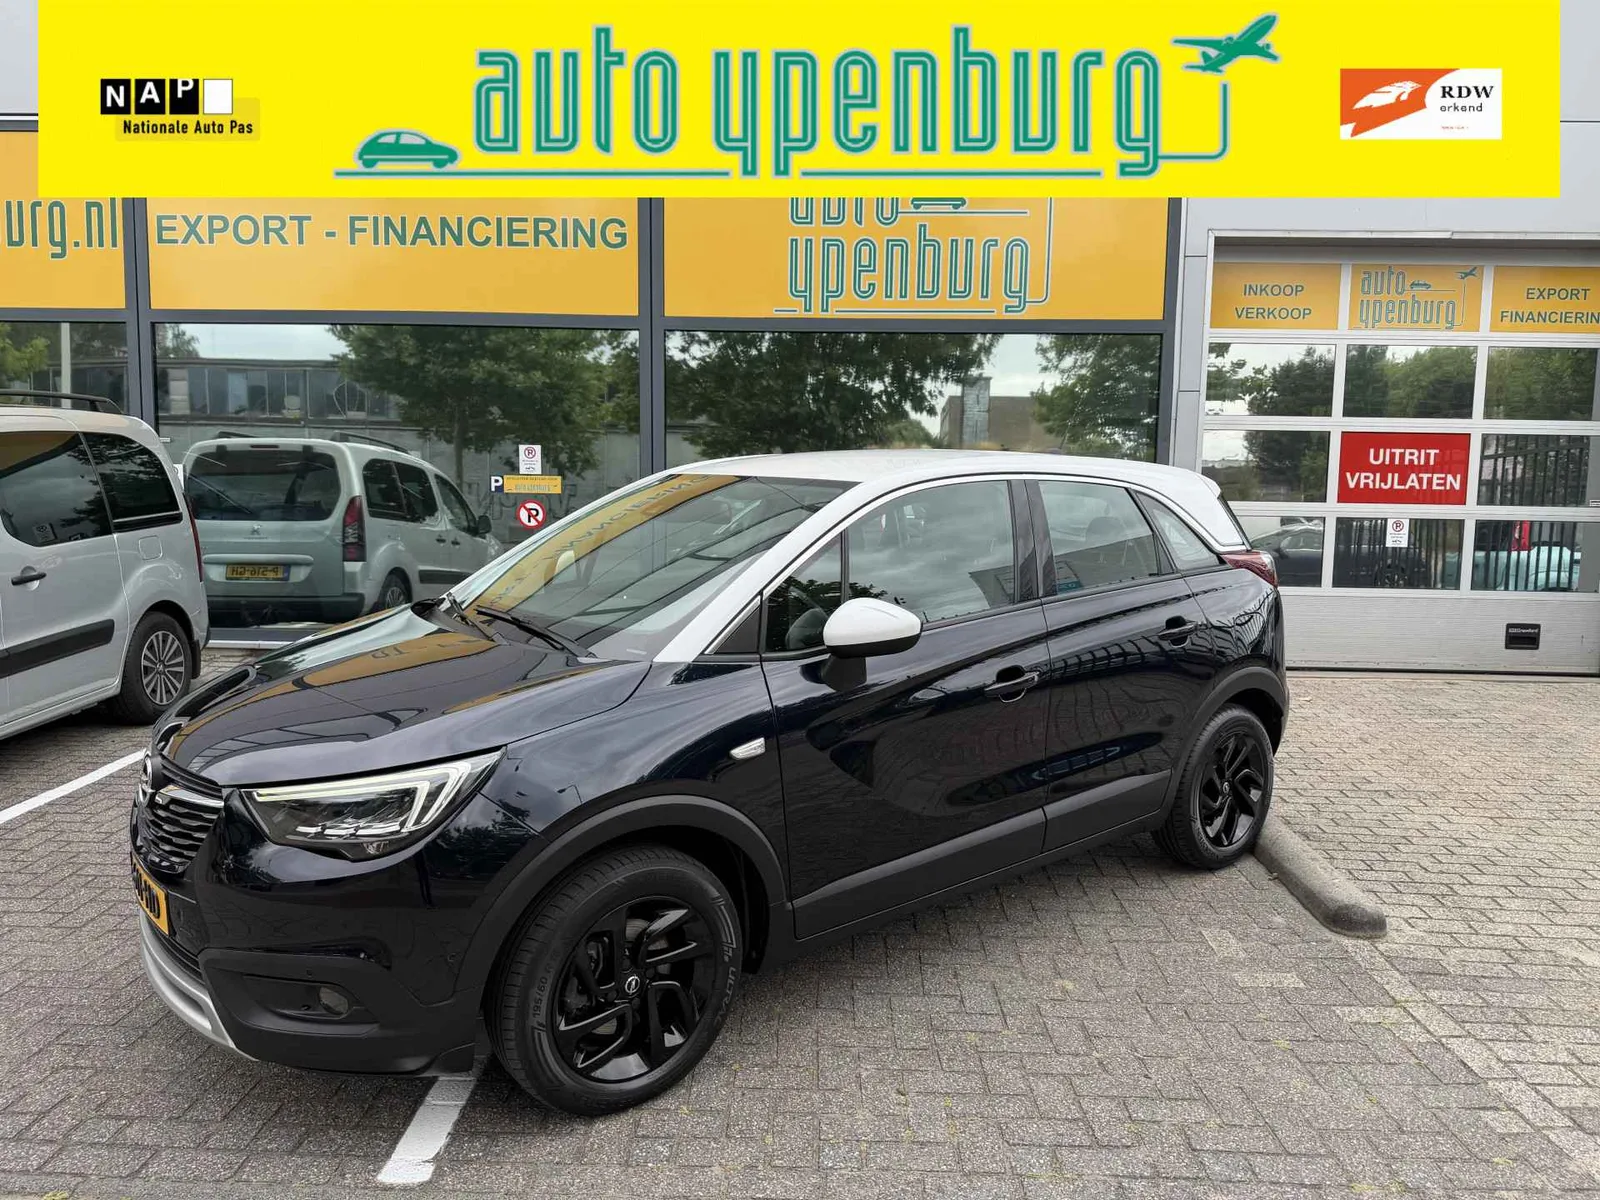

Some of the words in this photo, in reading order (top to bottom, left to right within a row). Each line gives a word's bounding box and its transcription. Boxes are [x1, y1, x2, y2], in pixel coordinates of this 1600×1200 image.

[156, 214, 312, 246] EXPORT
[348, 215, 629, 249] FINANCIERING
[788, 223, 1030, 313] ypenburg
[1360, 266, 1406, 295] auto
[1243, 284, 1304, 297] INKOOP
[1526, 287, 1590, 301] EXPORT
[1235, 307, 1312, 320] VERKOOP
[1359, 294, 1456, 330] ypenburg
[1369, 448, 1439, 466] UITRIT
[490, 475, 503, 492] P
[1345, 471, 1461, 490] VRIJLATEN
